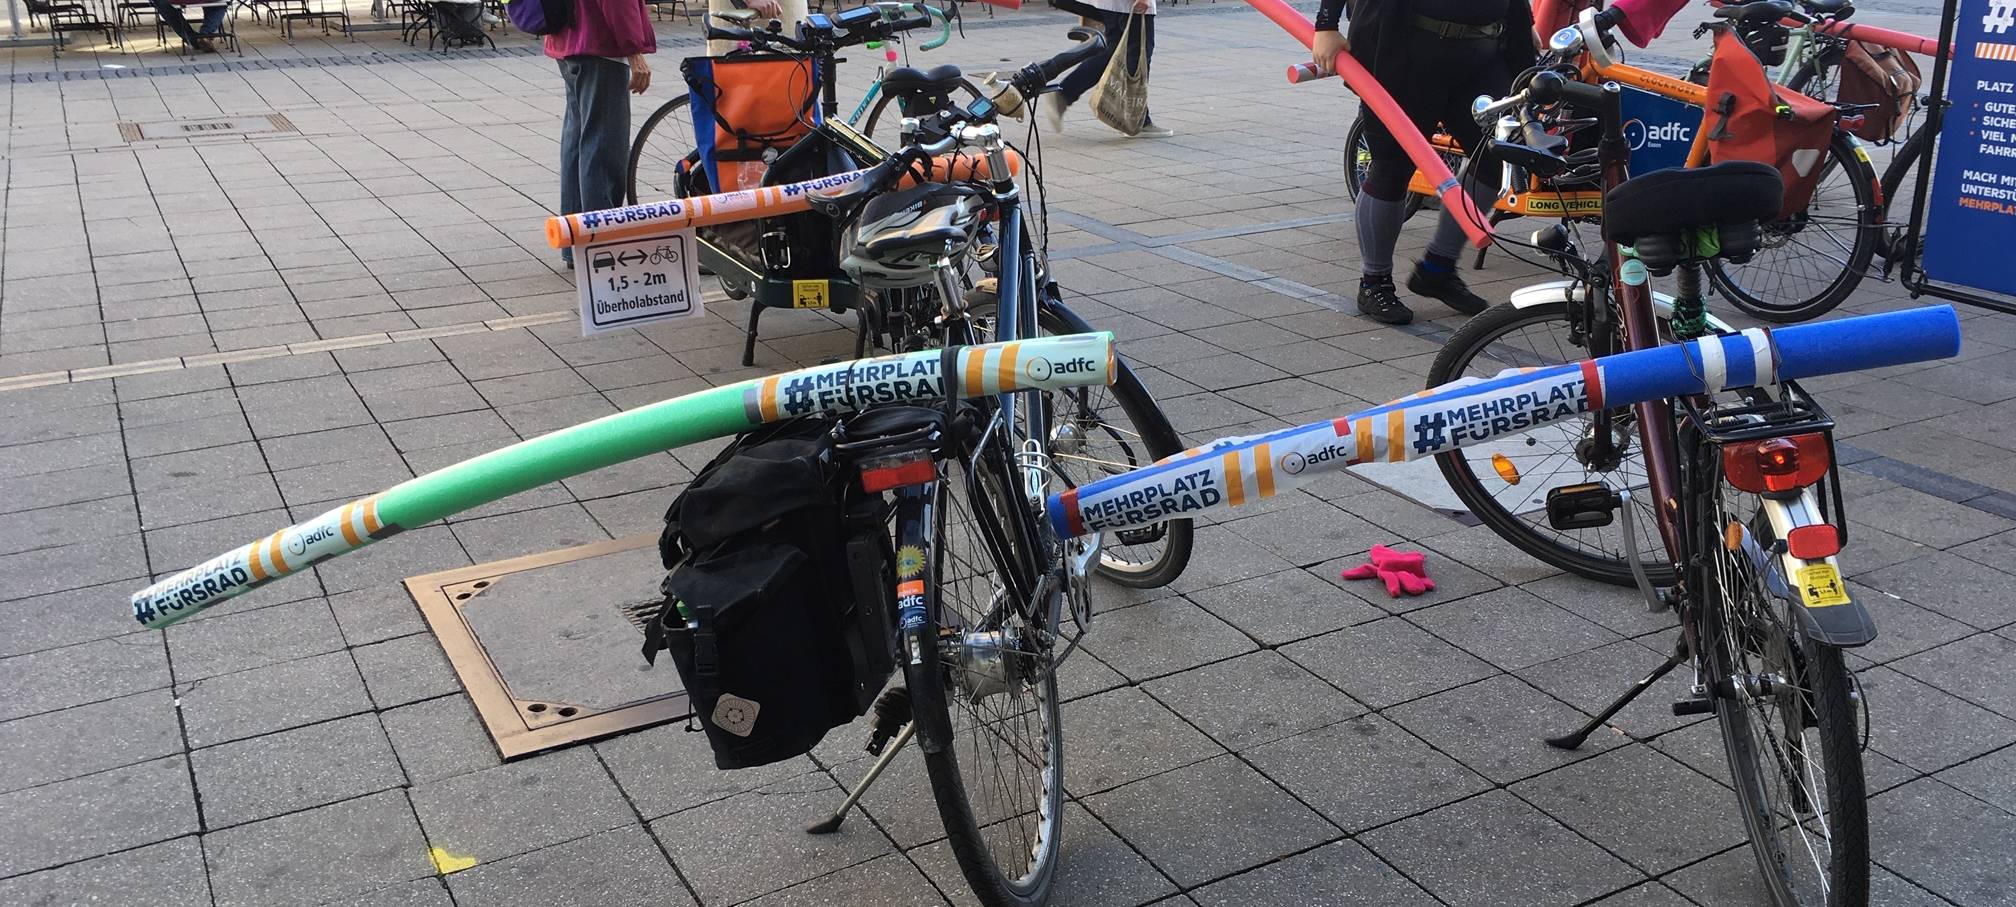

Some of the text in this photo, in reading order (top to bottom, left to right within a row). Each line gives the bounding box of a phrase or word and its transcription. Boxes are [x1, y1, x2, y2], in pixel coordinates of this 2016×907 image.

[1977, 80, 2014, 93] PLATZ
[1648, 122, 1690, 141] adfc
[1981, 129, 2007, 142] VIEL
[1963, 169, 1997, 183] MACH
[1530, 201, 1559, 210] LONG
[608, 275, 629, 292] 1,5
[643, 272, 667, 286] 2m
[597, 290, 685, 315] Überholabstand
[1054, 358, 1096, 374] adfc
[1308, 444, 1347, 466] adfc
[306, 529, 334, 545] adfc
[898, 595, 923, 610] adfc
